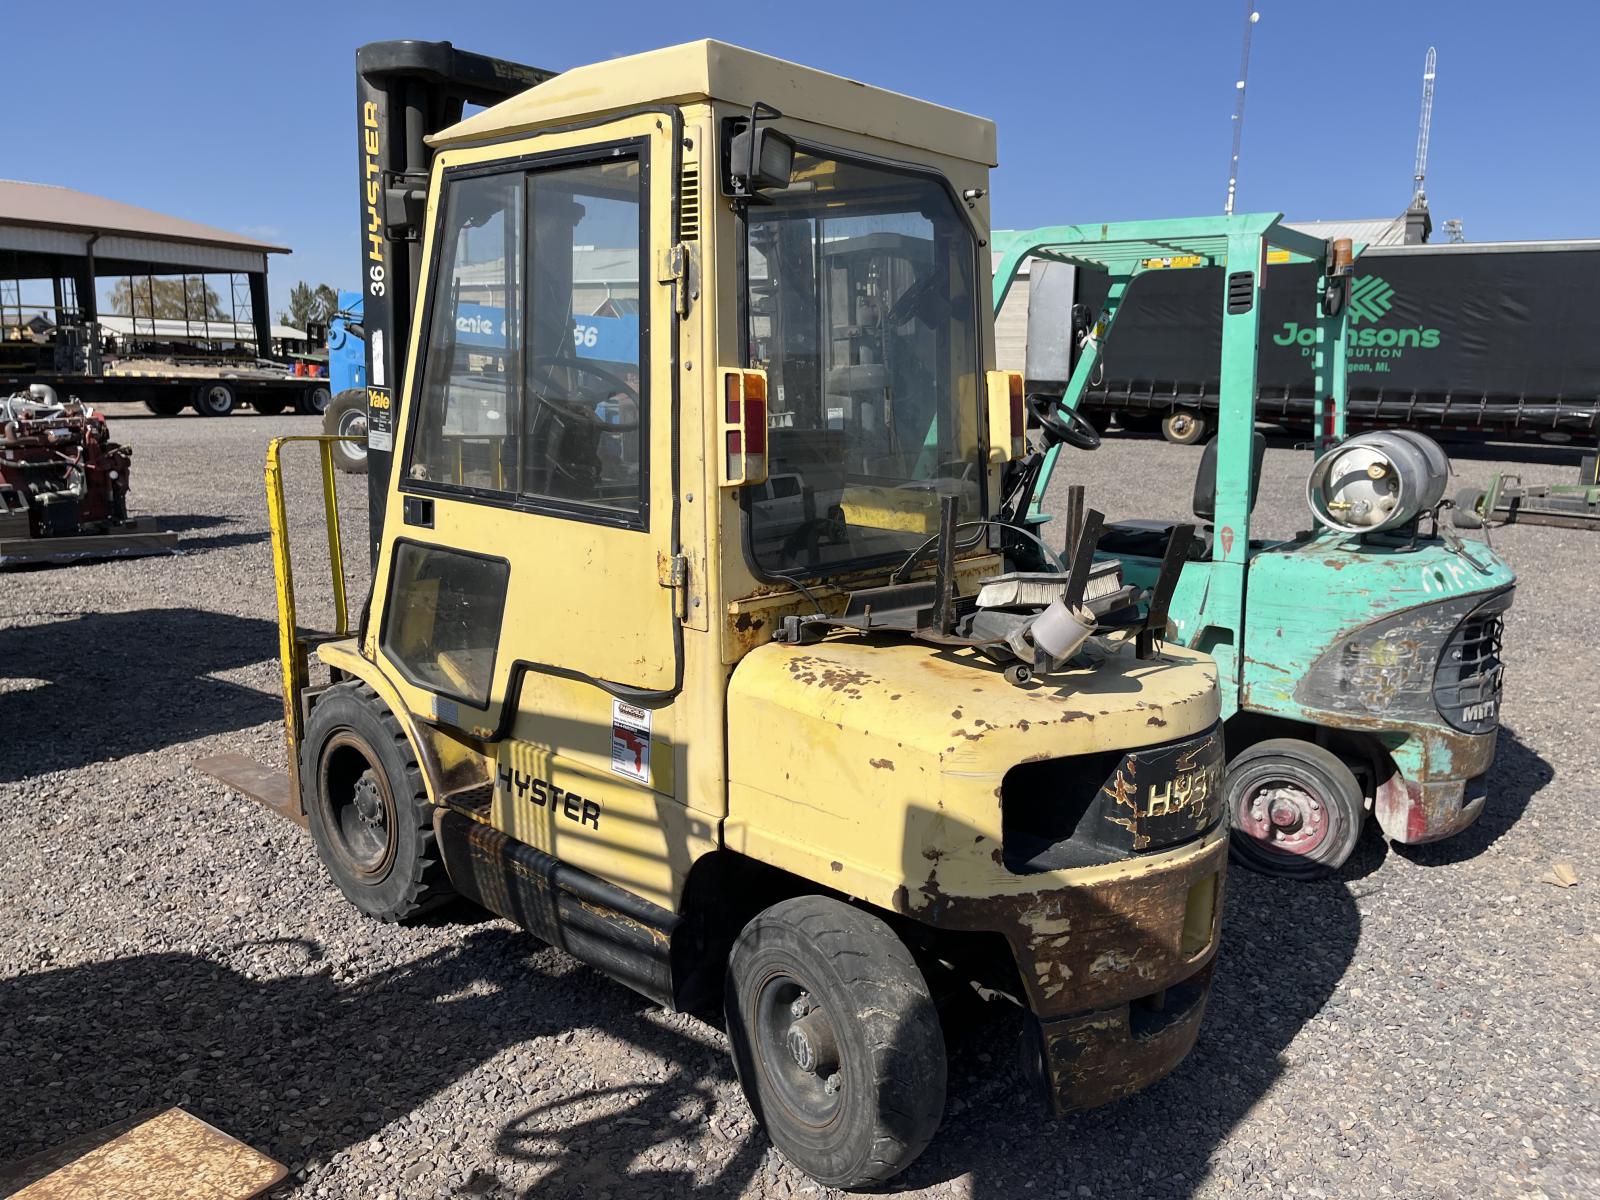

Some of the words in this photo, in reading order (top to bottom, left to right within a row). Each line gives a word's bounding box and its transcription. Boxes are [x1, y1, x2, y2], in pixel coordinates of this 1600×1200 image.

[364, 101, 383, 262] HYSTER
[370, 265, 385, 297] 36
[456, 315, 493, 335] enie
[1273, 322, 1441, 348] Jonson's
[1301, 347, 1402, 358] DIBUTION
[368, 390, 390, 410] Yale
[498, 763, 601, 831] HYSTER
